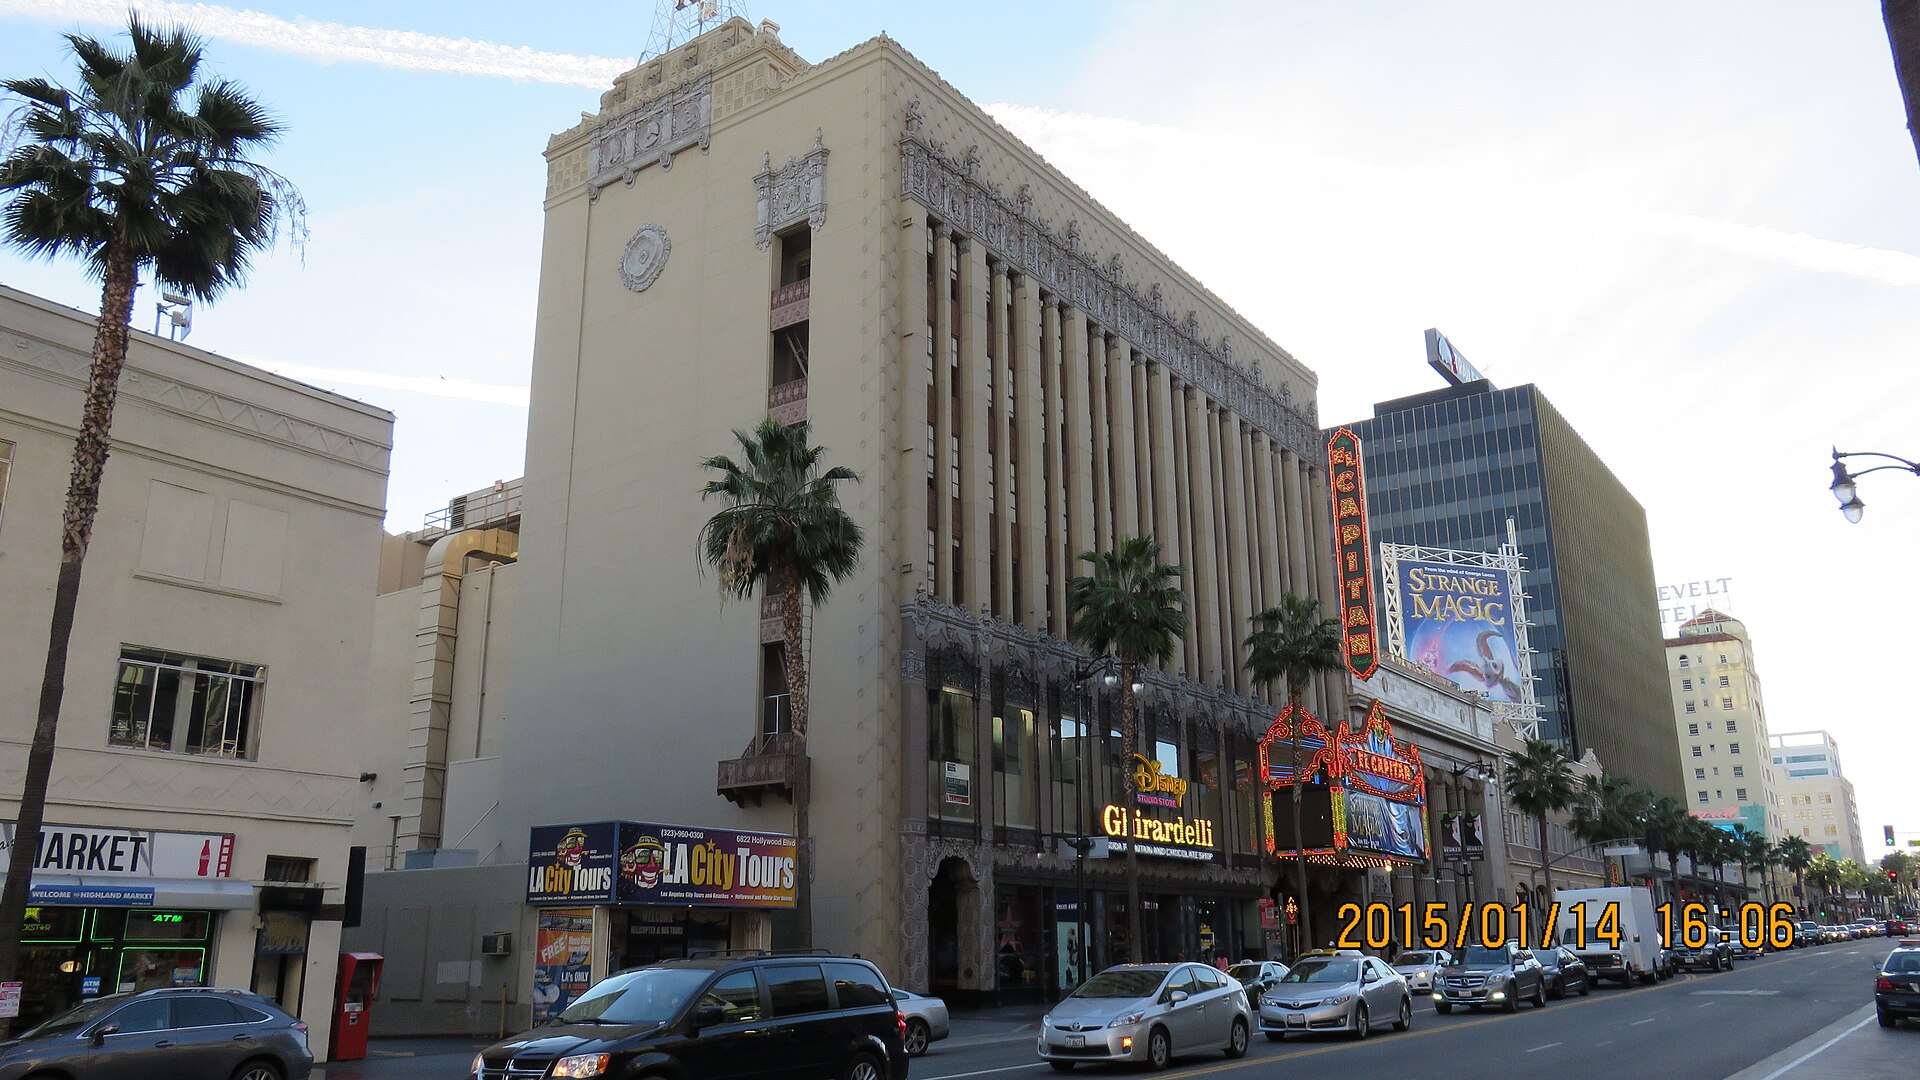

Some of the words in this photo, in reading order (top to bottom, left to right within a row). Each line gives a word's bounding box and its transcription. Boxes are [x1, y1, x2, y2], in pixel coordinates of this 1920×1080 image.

[1332, 446, 1357, 467] EL
[1336, 470, 1371, 656] CAPITAN
[1407, 568, 1502, 597] STRANGE
[1657, 577, 1732, 602] EVELT
[1408, 593, 1505, 626] MAGIC
[1659, 604, 1697, 623] TEL
[1137, 794, 1158, 805] STUDIO
[1159, 797, 1177, 808] STORE
[736, 834, 750, 844] 6822
[751, 835, 782, 847] Hollywood
[782, 838, 796, 847] Blvd
[662, 842, 689, 884] LA
[691, 838, 736, 890] City
[737, 847, 794, 889] Tours
[1166, 848, 1199, 859] CHOCOLATE
[1199, 851, 1214, 860] SHOP
[529, 866, 544, 893] LA
[545, 862, 572, 895] City
[573, 864, 612, 892] Tours
[32, 891, 71, 899] WELCOME
[123, 892, 153, 900] MARKET
[669, 890, 684, 898] Angeles
[152, 914, 183, 923] ATM
[541, 935, 567, 962] FREE
[561, 971, 573, 983] LA's
[574, 971, 589, 983] ONLY
